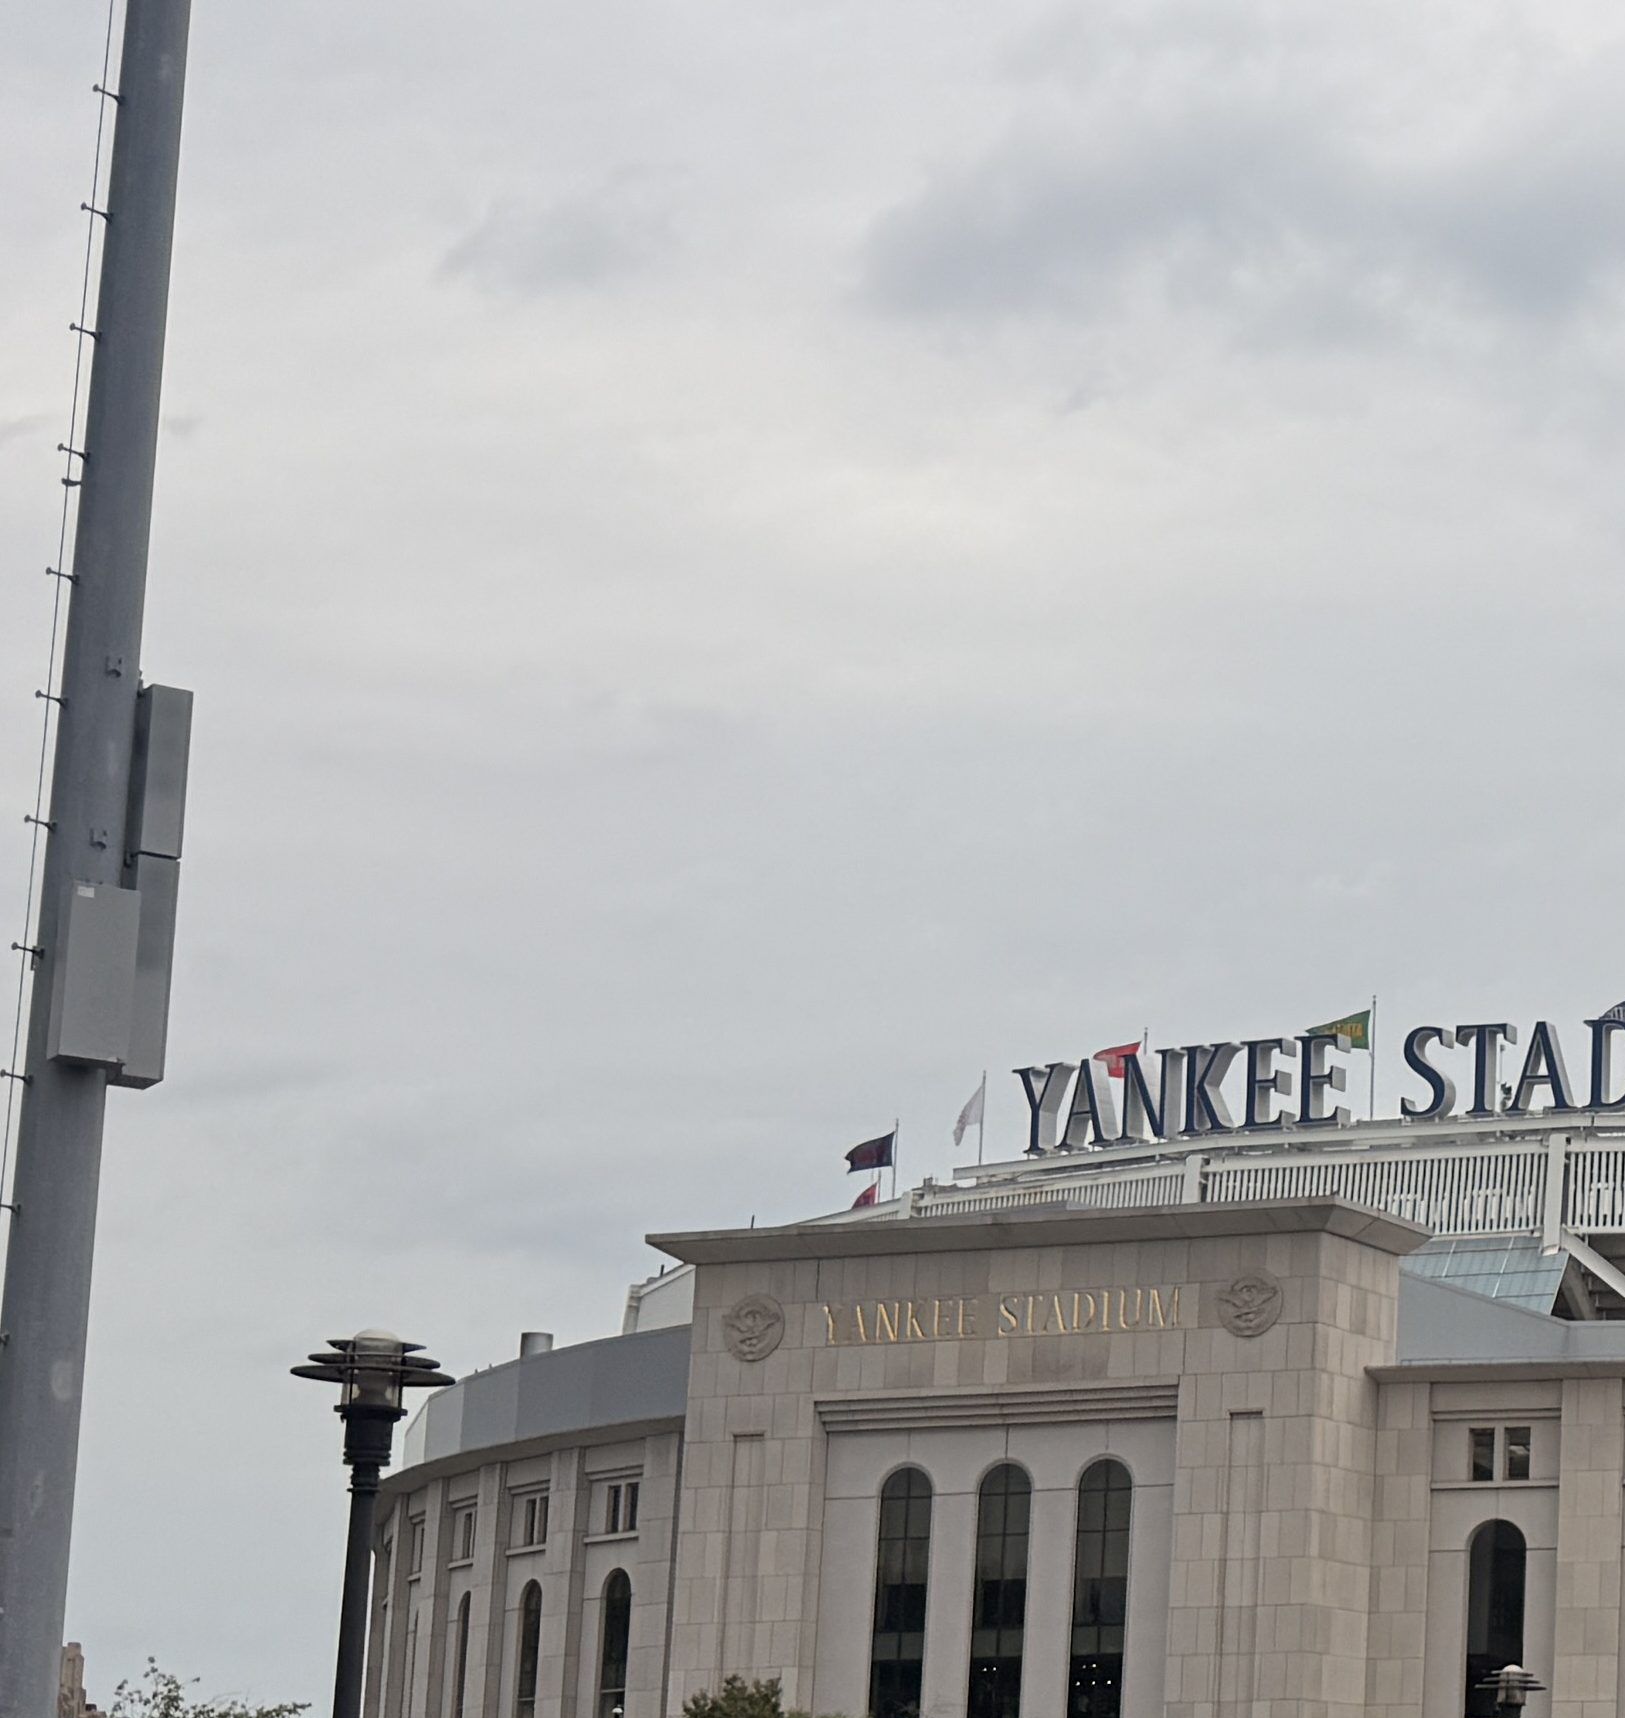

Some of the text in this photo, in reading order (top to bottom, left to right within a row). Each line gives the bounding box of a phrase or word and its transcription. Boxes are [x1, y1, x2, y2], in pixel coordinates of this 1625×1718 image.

[1012, 1033, 1350, 1155] YANKEE
[822, 1287, 1182, 1344] YANKEE STADIUM
